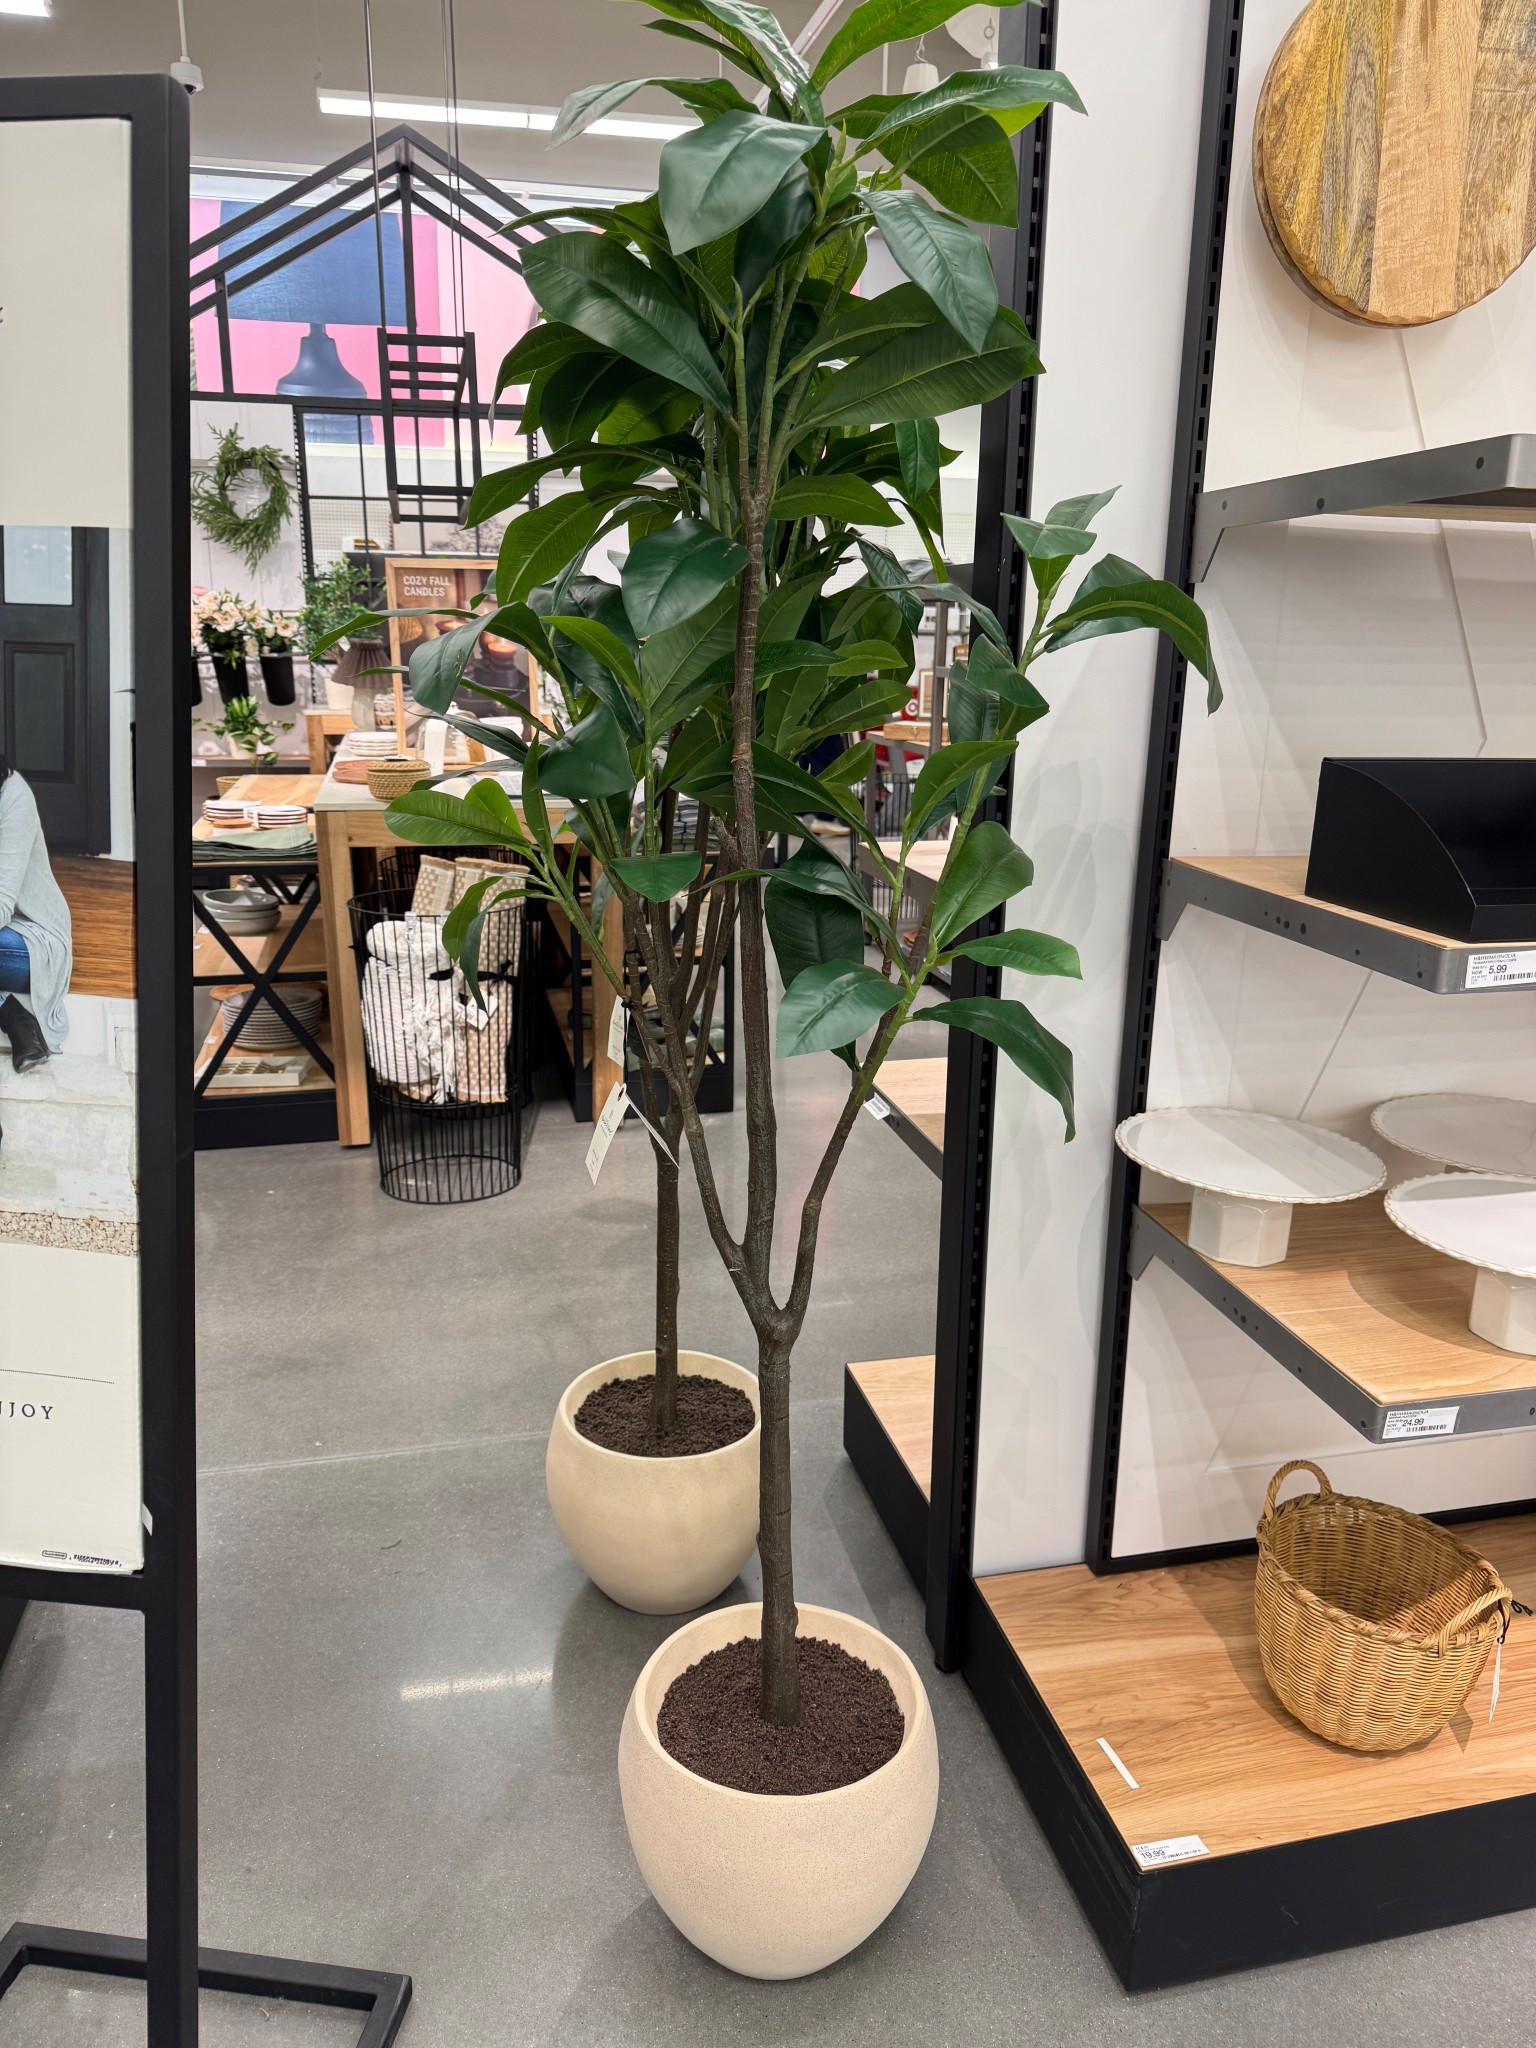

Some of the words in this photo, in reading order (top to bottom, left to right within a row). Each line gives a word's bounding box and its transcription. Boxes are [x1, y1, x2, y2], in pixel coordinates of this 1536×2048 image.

[403, 575, 428, 586] COZY
[429, 576, 451, 586] FALL
[404, 586, 446, 597] CANDLES
[1488, 964, 1507, 975] 5.99
[0, 1401, 54, 1420] JOY
[1402, 1417, 1425, 1427] 24.99
[1140, 1849, 1166, 1860] 19.99
